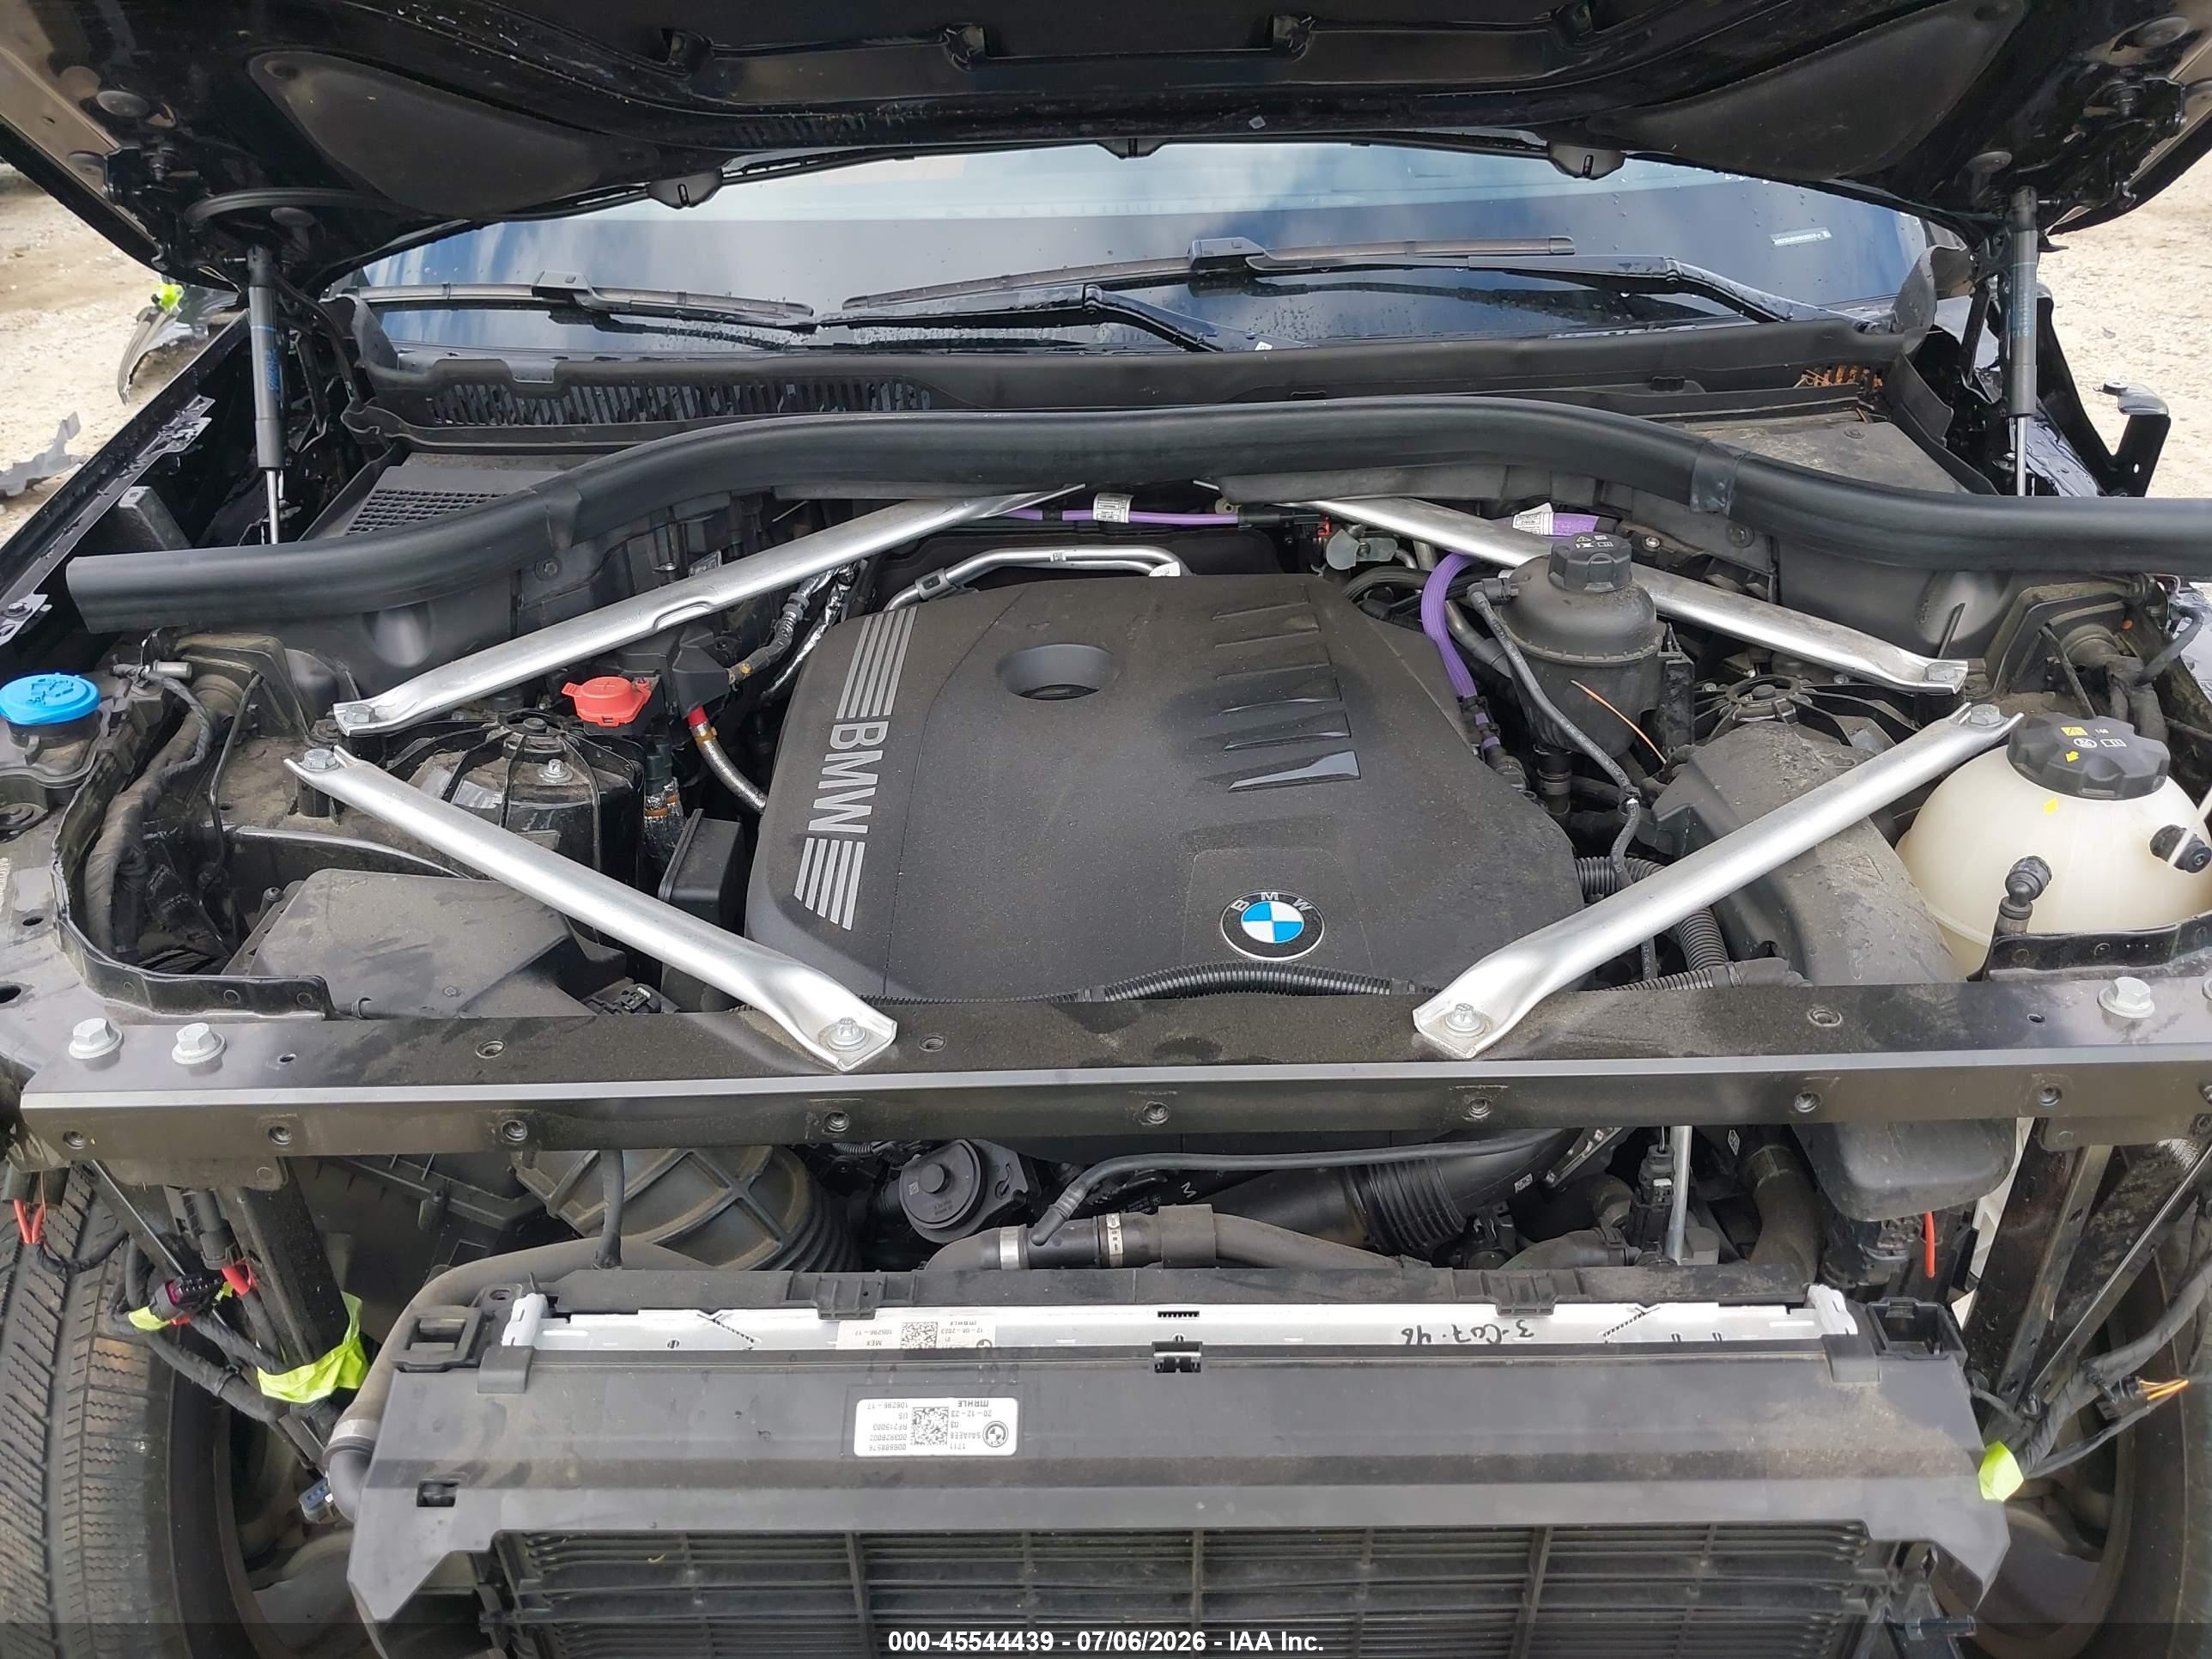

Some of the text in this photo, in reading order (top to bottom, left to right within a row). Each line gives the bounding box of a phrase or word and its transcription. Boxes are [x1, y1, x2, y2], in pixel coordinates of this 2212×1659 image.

[807, 720, 890, 835] BMW
[1231, 891, 1313, 912] BMW
[957, 1399, 989, 1407] MAHLE
